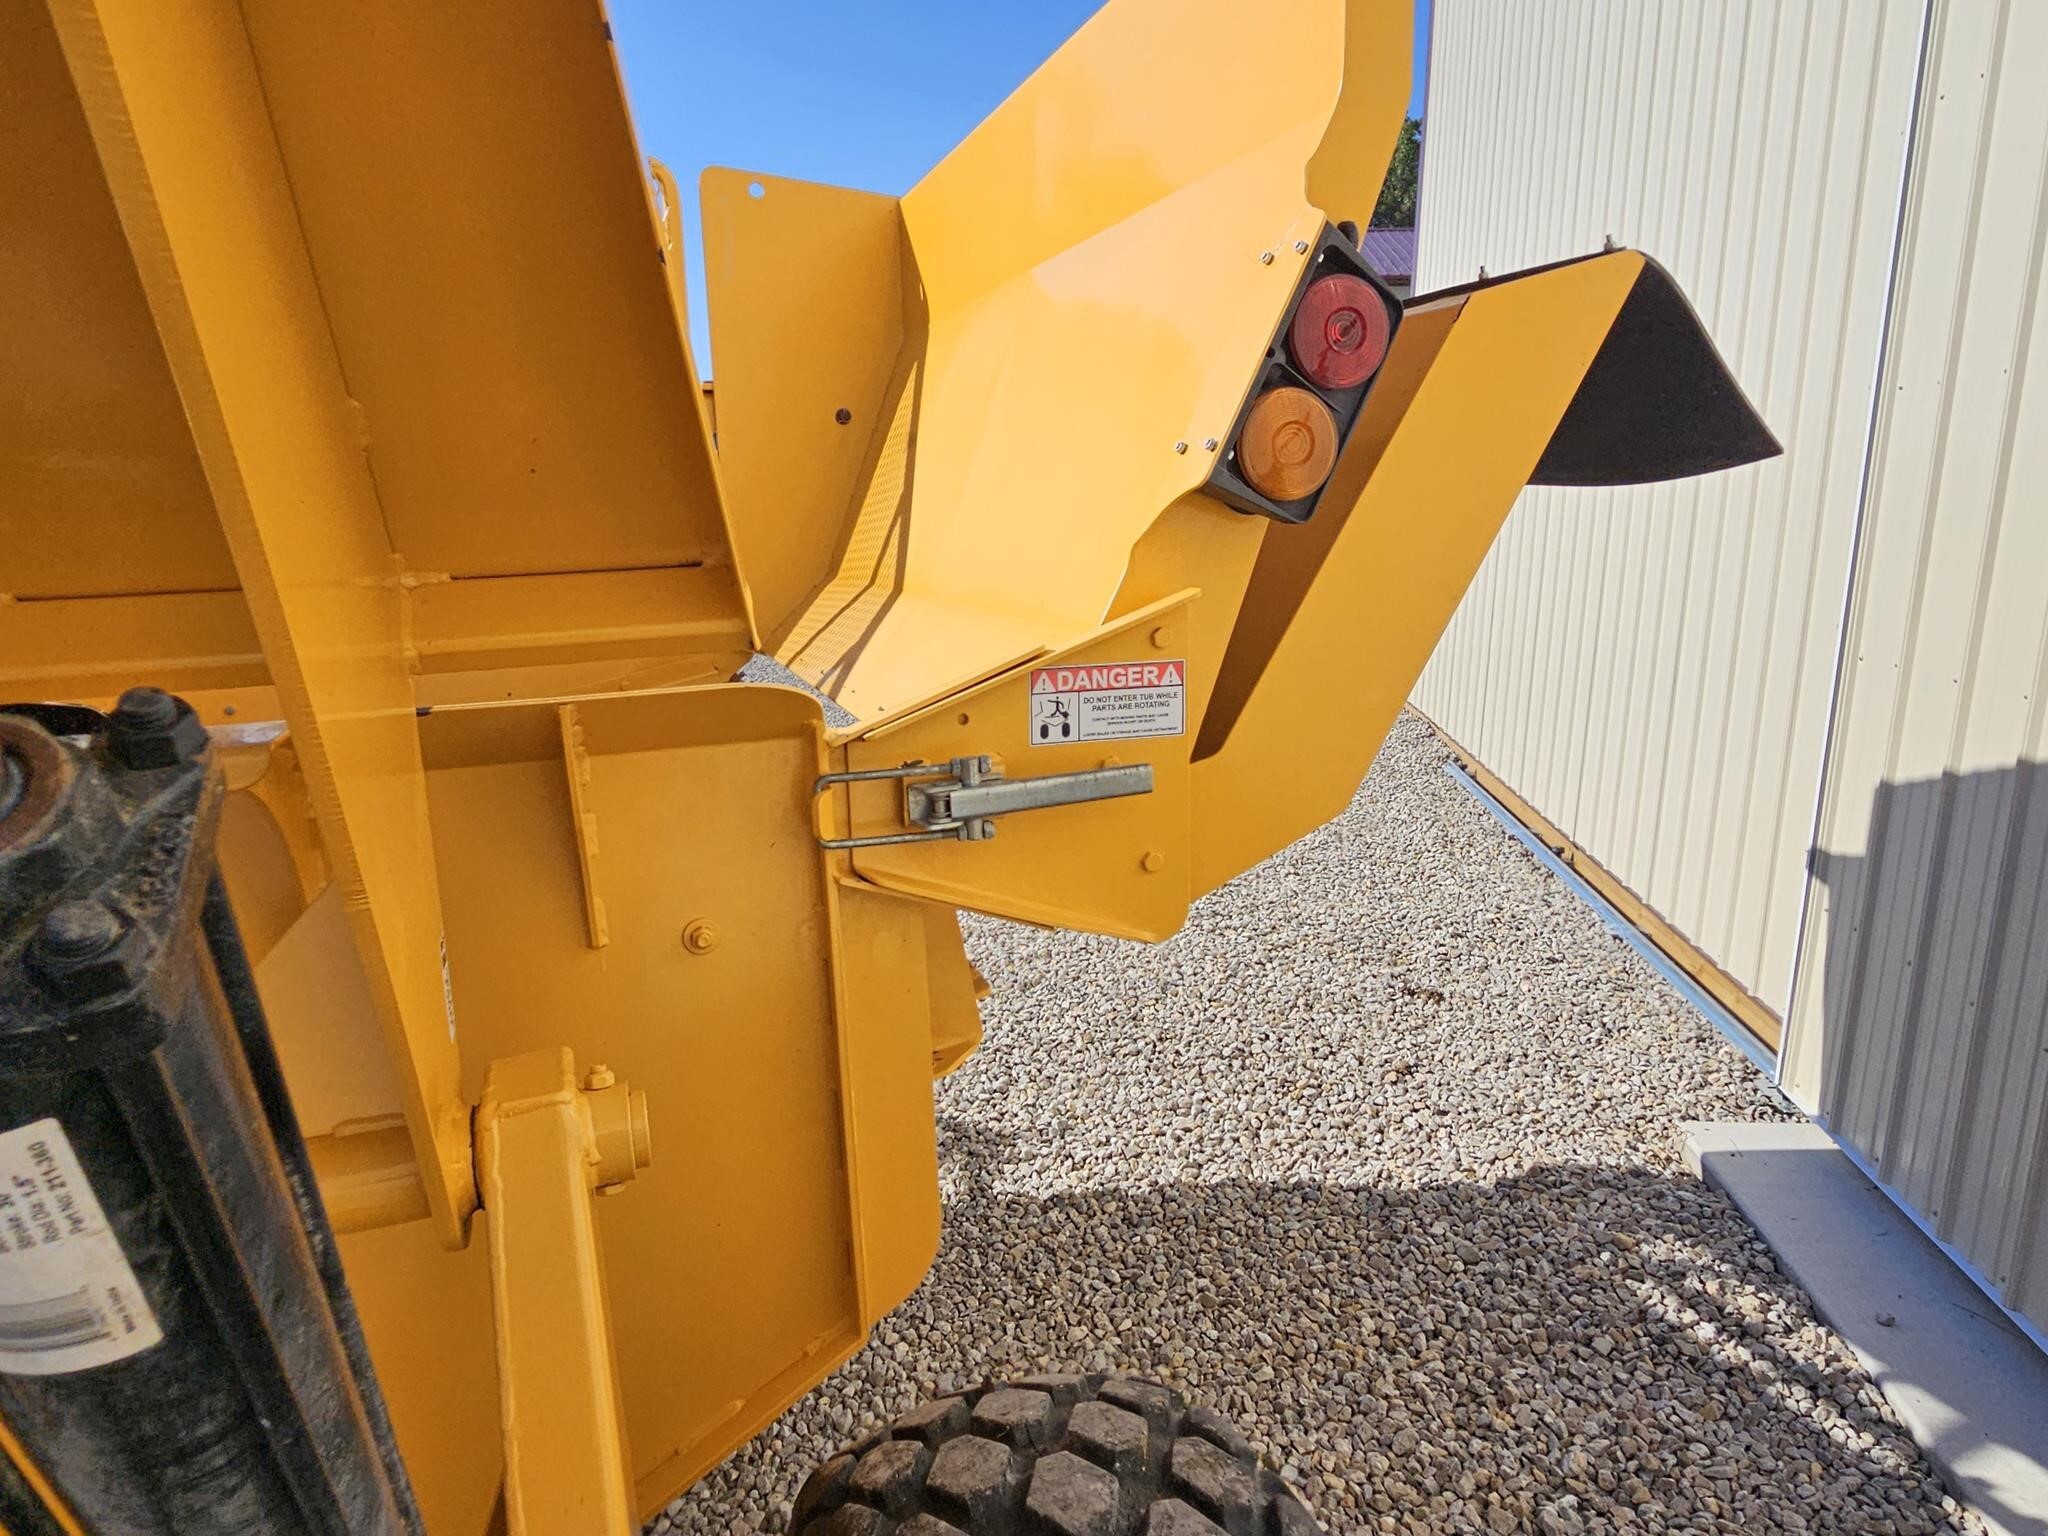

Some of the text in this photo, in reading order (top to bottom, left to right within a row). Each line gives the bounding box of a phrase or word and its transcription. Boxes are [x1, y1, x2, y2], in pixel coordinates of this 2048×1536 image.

[1057, 666, 1160, 691] DANGER
[1096, 695, 1112, 703] NOT
[1113, 694, 1137, 702] ENTER
[1140, 693, 1154, 701] TUB
[1155, 691, 1178, 700] WHILE
[1091, 700, 1170, 712] PARTS ARE ROTATING
